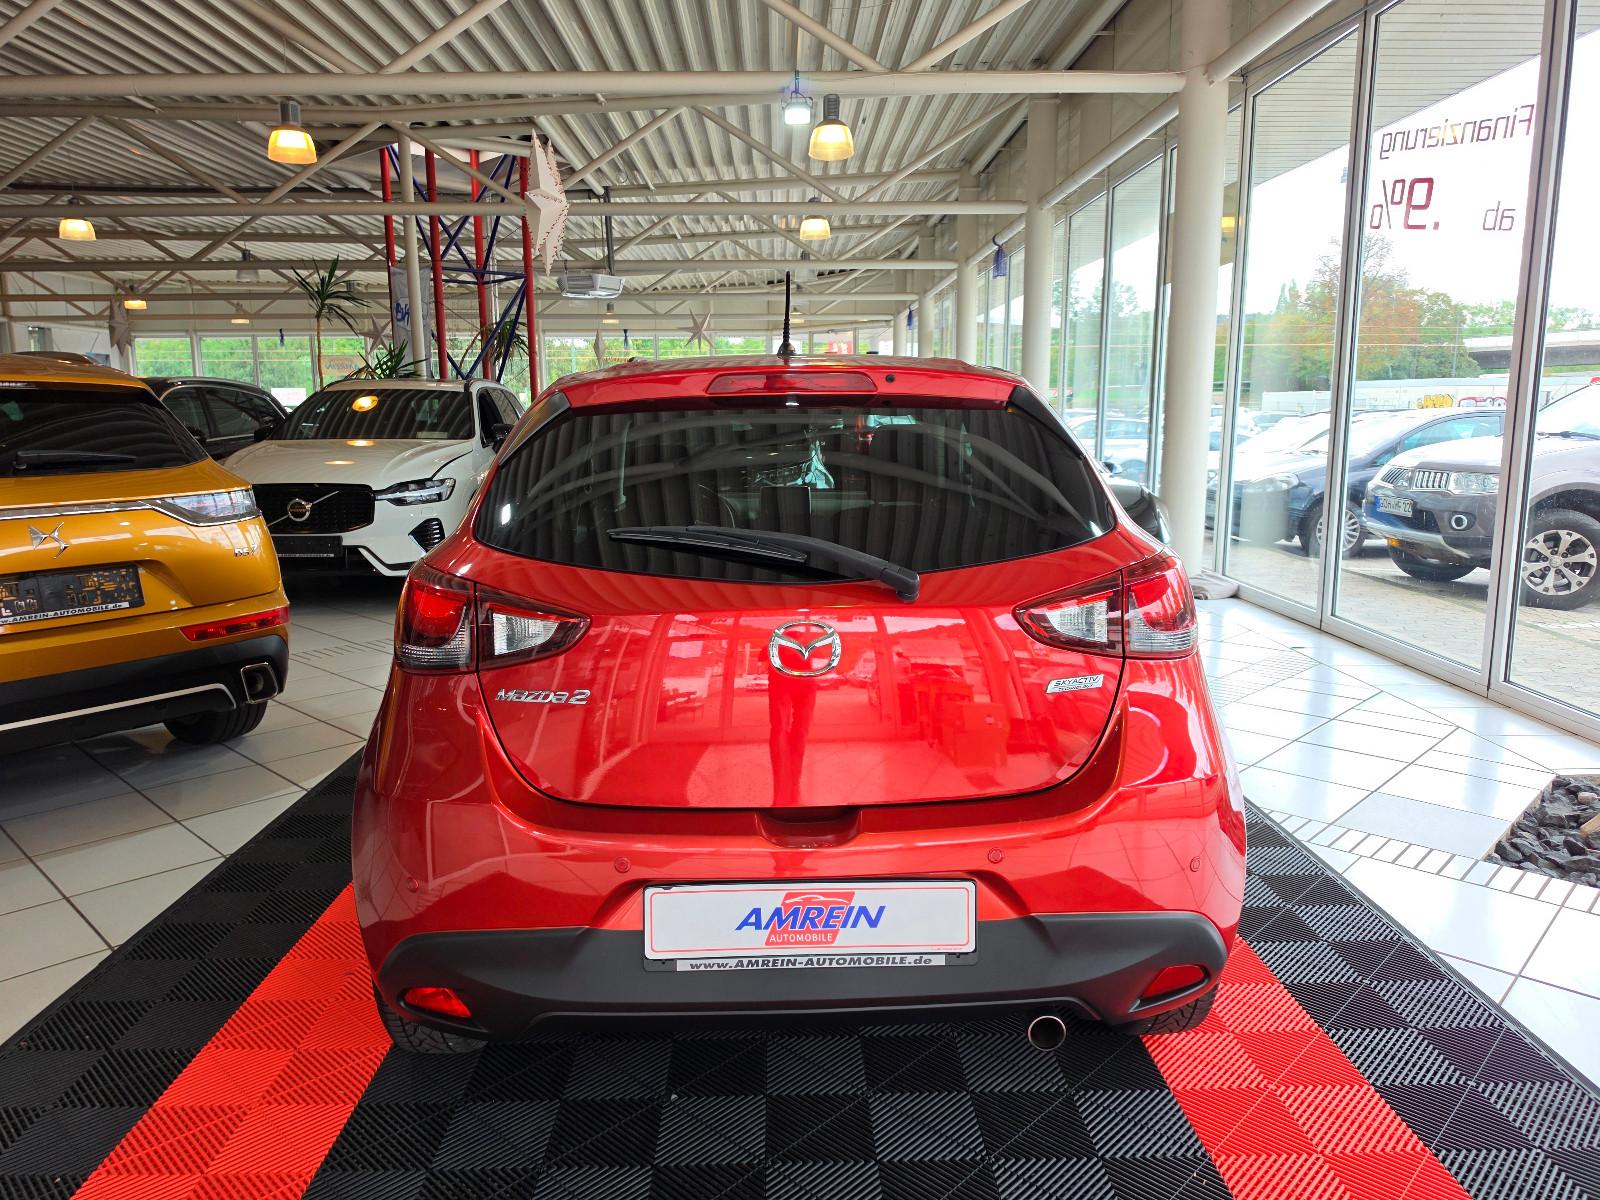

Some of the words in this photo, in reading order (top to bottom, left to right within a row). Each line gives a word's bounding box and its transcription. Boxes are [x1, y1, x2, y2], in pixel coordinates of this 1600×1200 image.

[1053, 675, 1099, 687] SKYACTIV
[568, 689, 591, 705] 2
[735, 905, 887, 931] AMREIN
[768, 933, 834, 943] AUTOMOBILE
[689, 956, 933, 970] www.AMREIN-AUTOMOBILE.de
